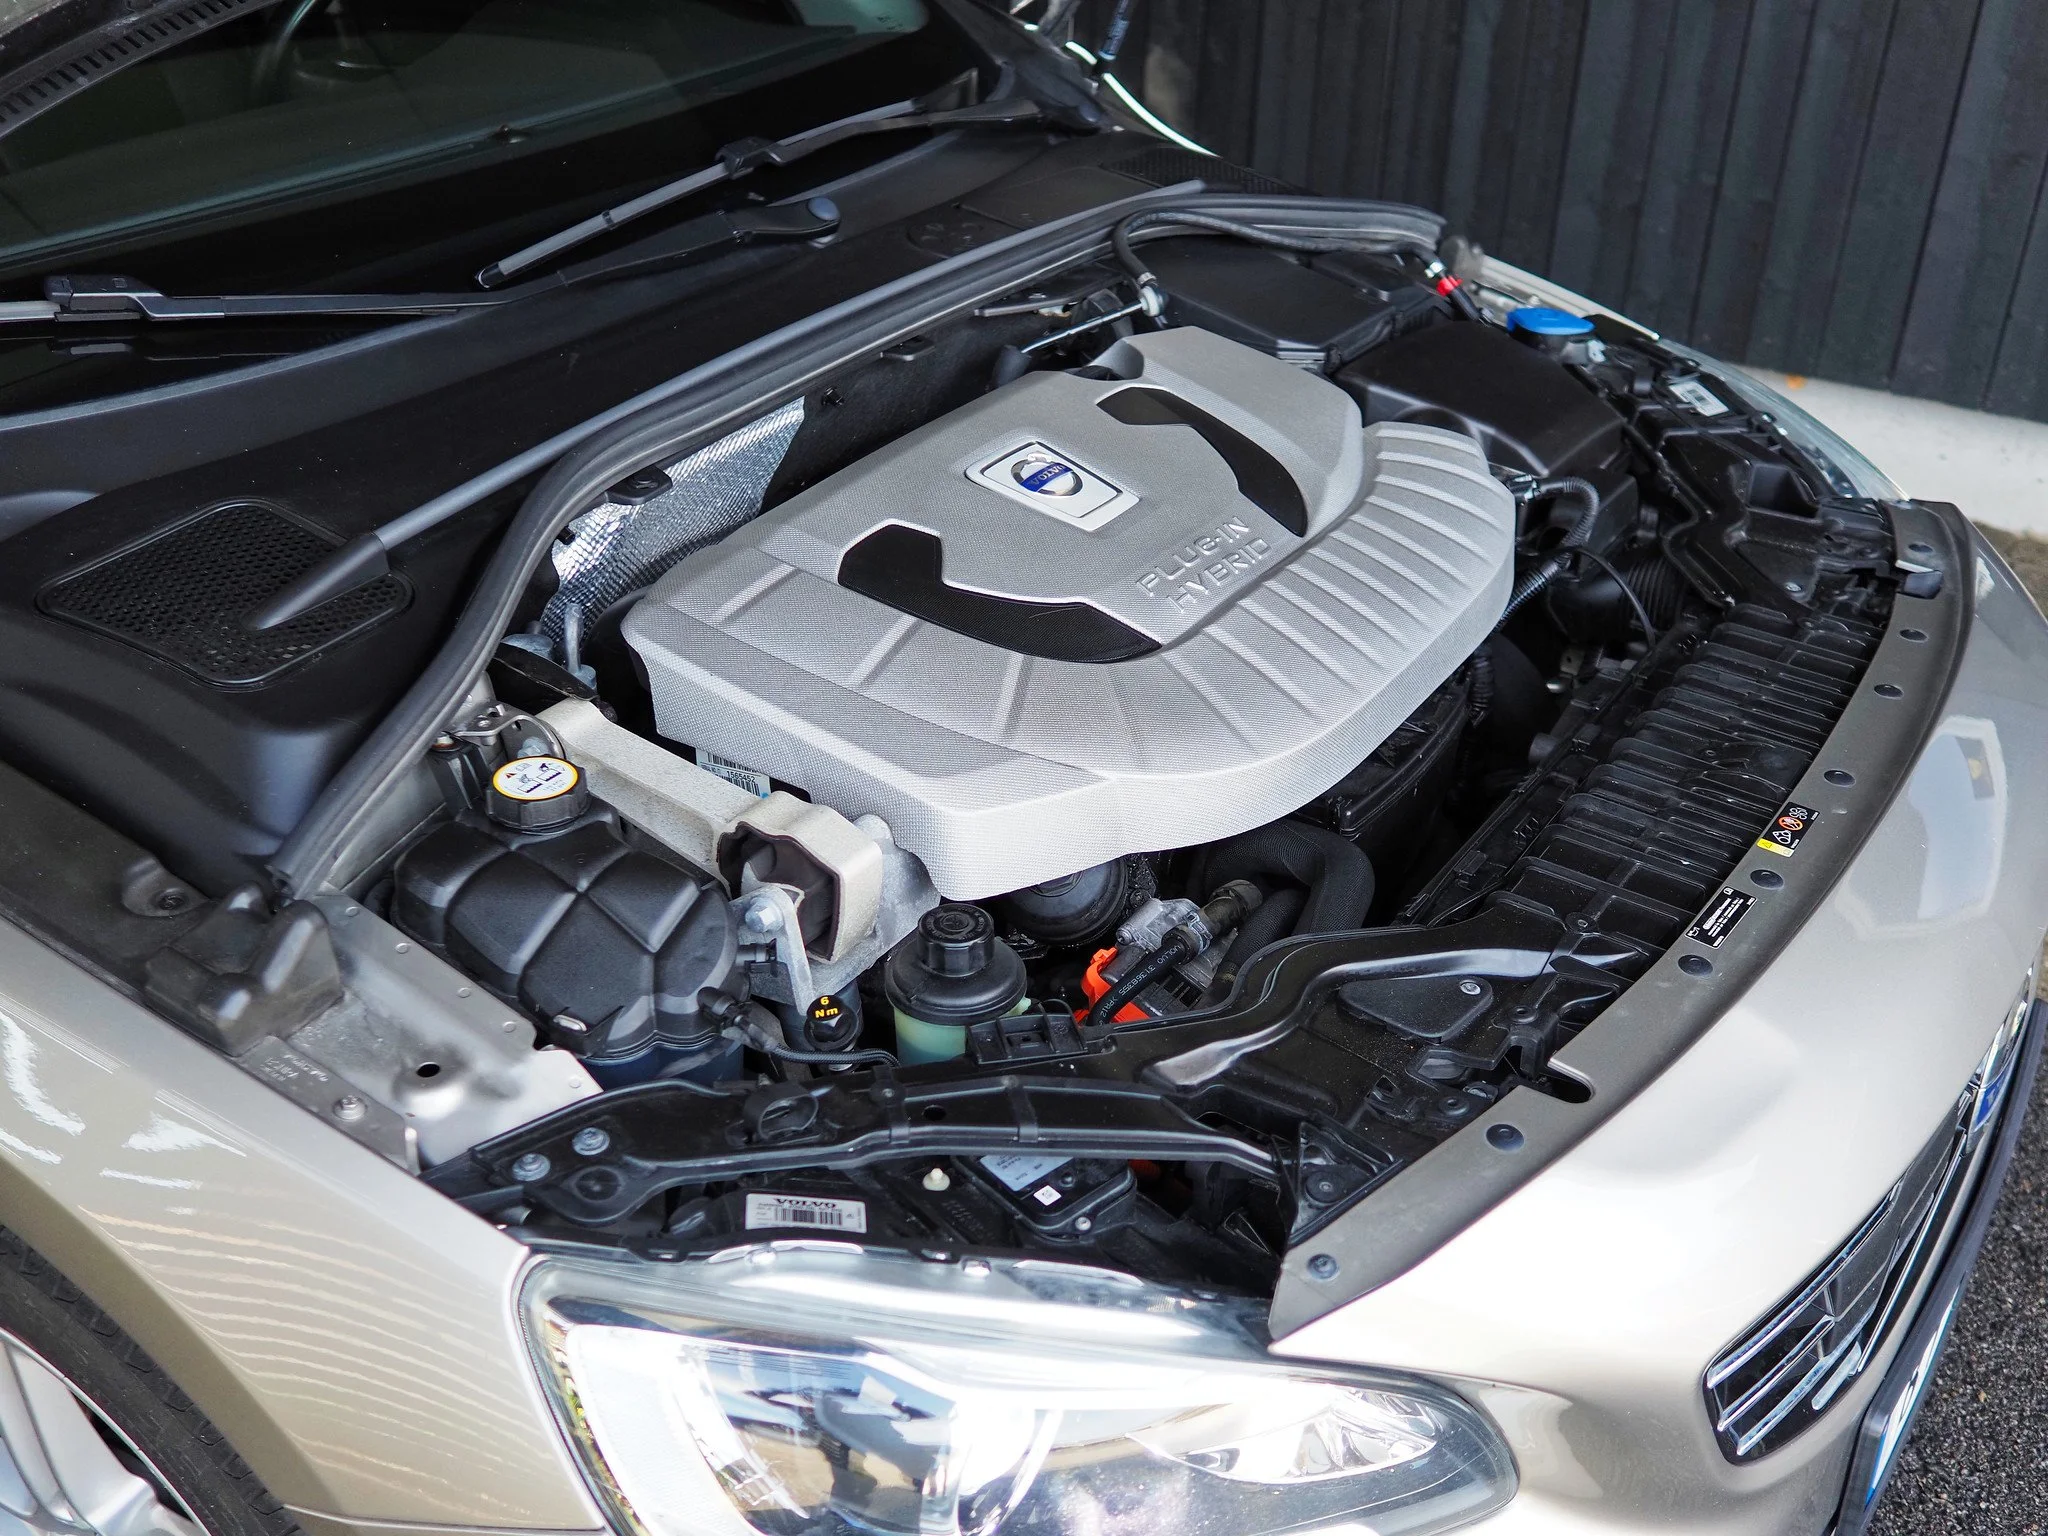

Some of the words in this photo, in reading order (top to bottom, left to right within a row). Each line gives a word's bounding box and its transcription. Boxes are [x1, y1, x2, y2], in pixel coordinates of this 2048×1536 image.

[1028, 464, 1067, 485] VOLVO
[1135, 516, 1249, 597] PLUG-IN
[1165, 537, 1273, 614] HYBRID
[1156, 944, 1182, 965] VOLVO
[820, 996, 830, 1006] 6
[773, 1198, 837, 1209] VOLVO
